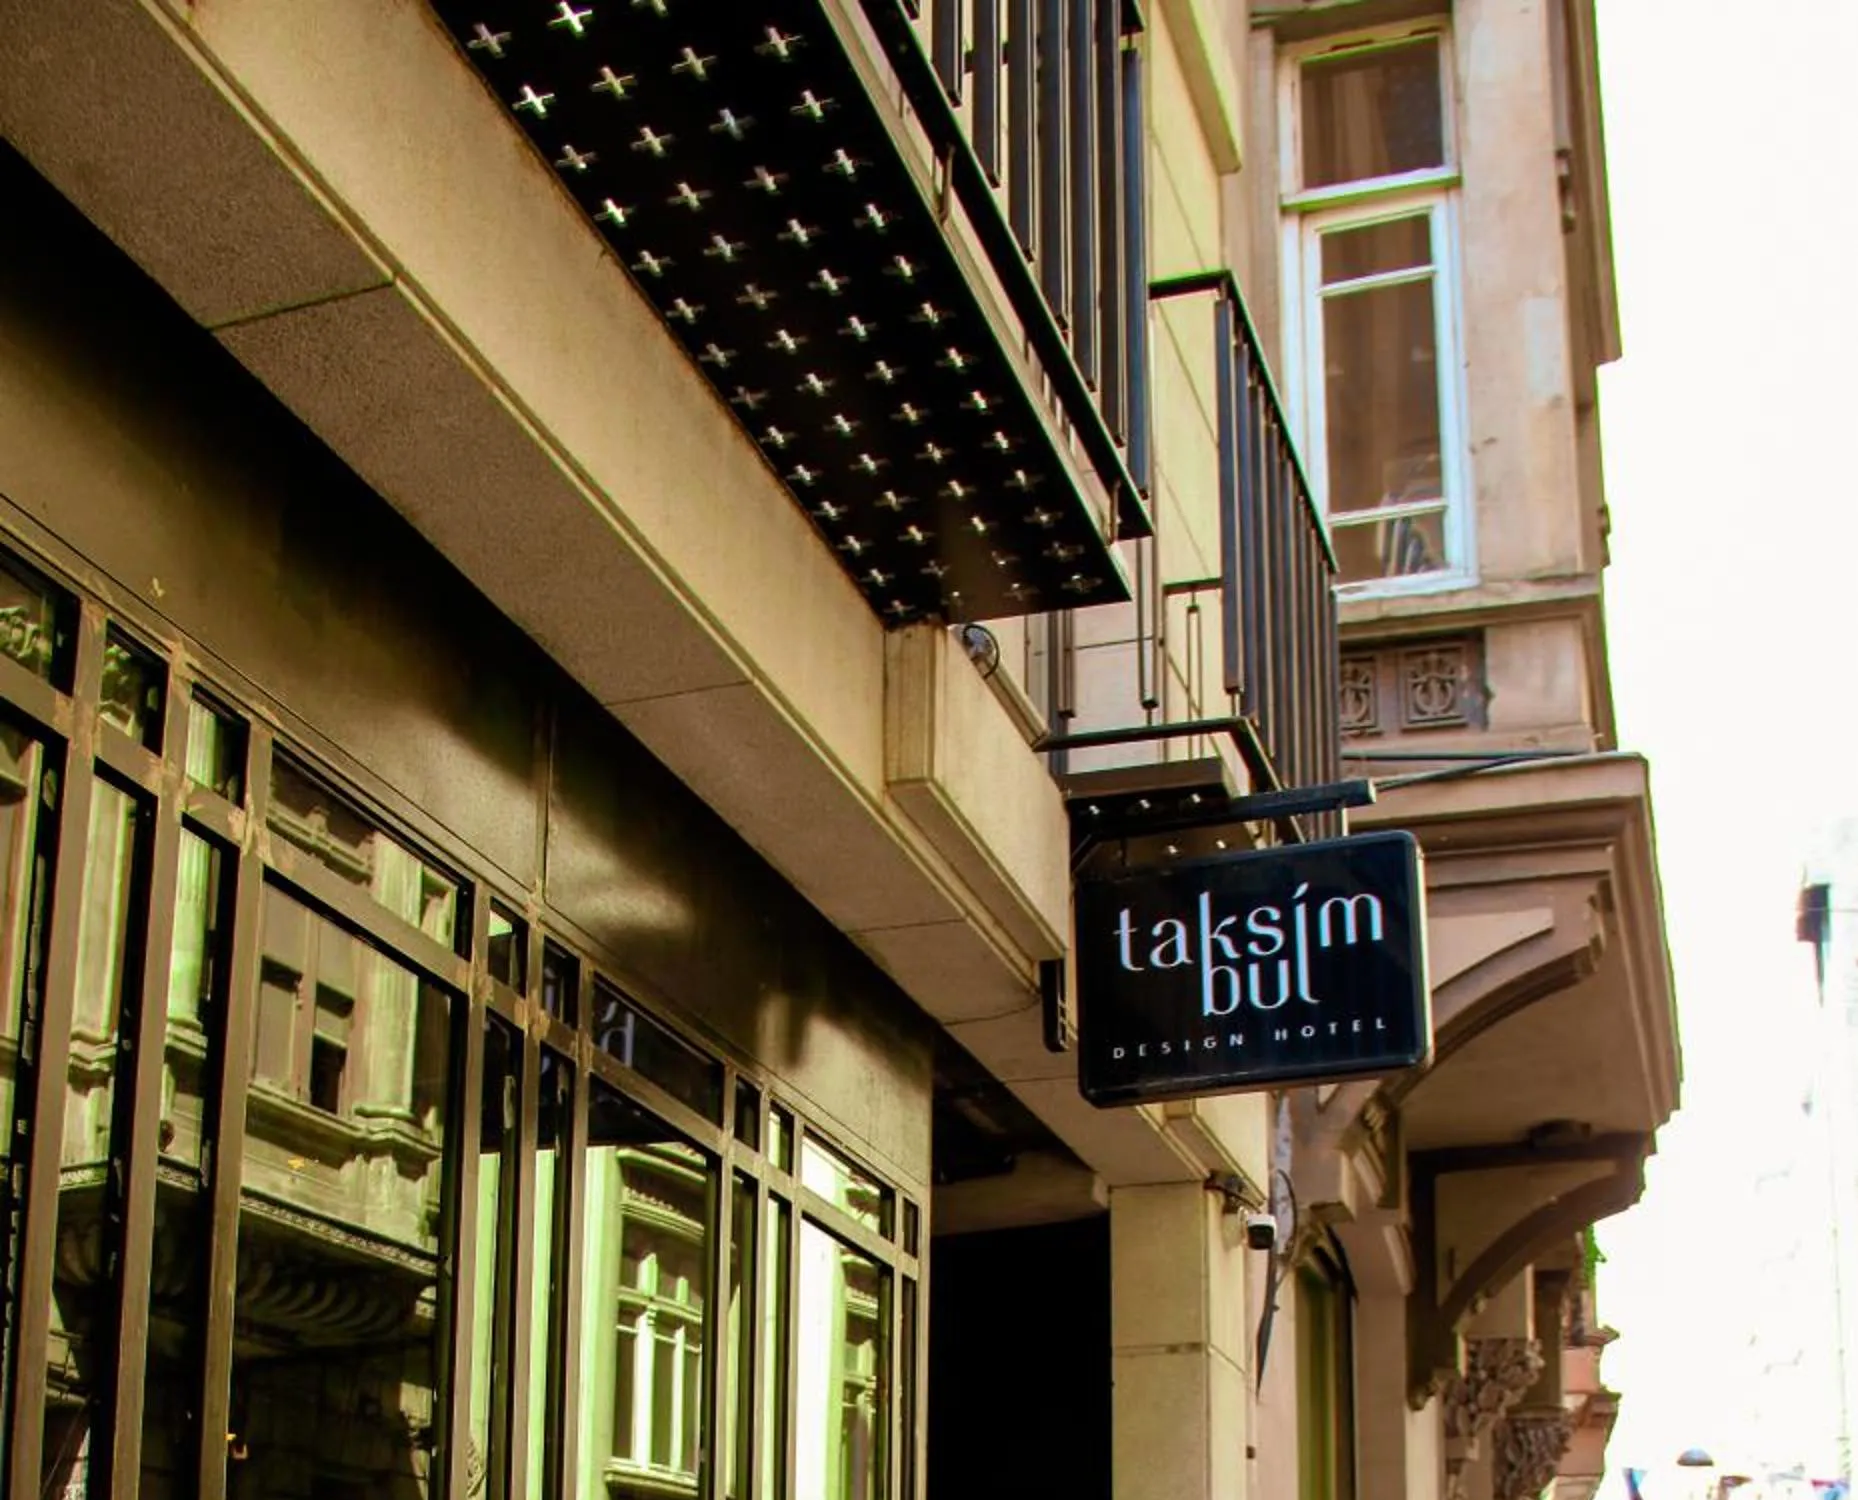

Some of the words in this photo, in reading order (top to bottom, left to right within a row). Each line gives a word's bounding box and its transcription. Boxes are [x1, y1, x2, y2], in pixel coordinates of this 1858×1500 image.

[1113, 881, 1384, 972] taksim
[1201, 958, 1320, 1017] bul
[1112, 1033, 1244, 1060] DESIGN
[1274, 1016, 1387, 1042] HOTEL
